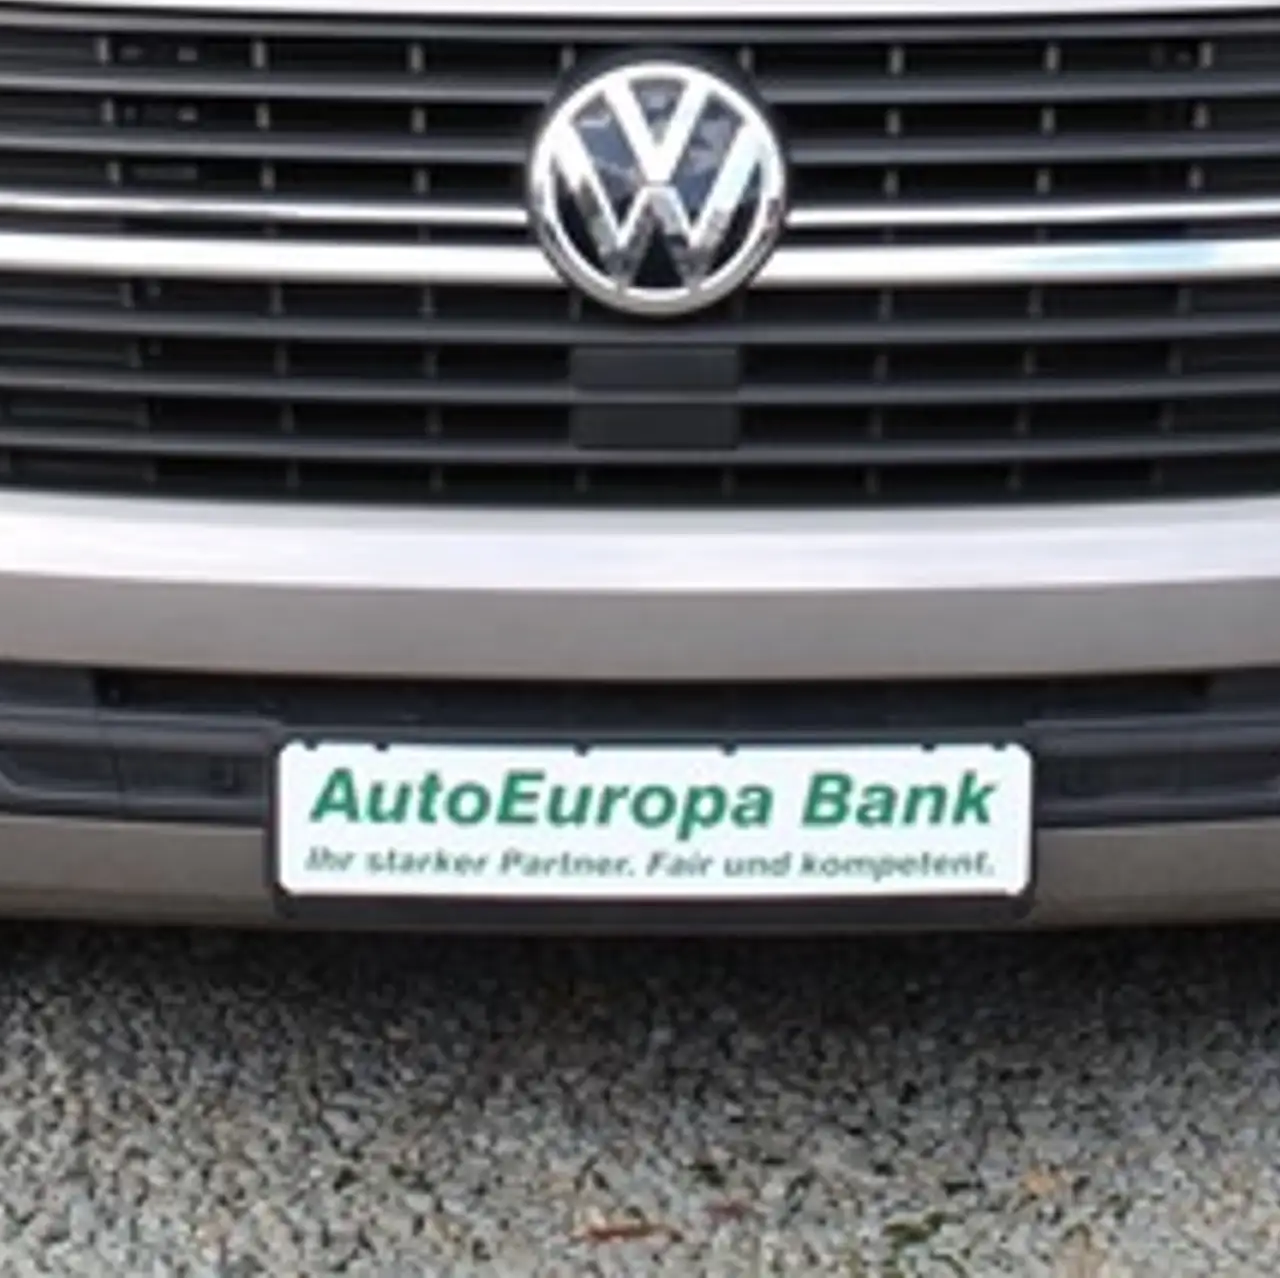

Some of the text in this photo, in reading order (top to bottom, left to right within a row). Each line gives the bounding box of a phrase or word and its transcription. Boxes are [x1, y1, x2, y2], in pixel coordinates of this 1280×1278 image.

[532, 63, 786, 315] VW
[308, 766, 997, 842] AutoEuropa Bank
[305, 845, 995, 883] Ihr starker Partner. Fair und kompetent.
